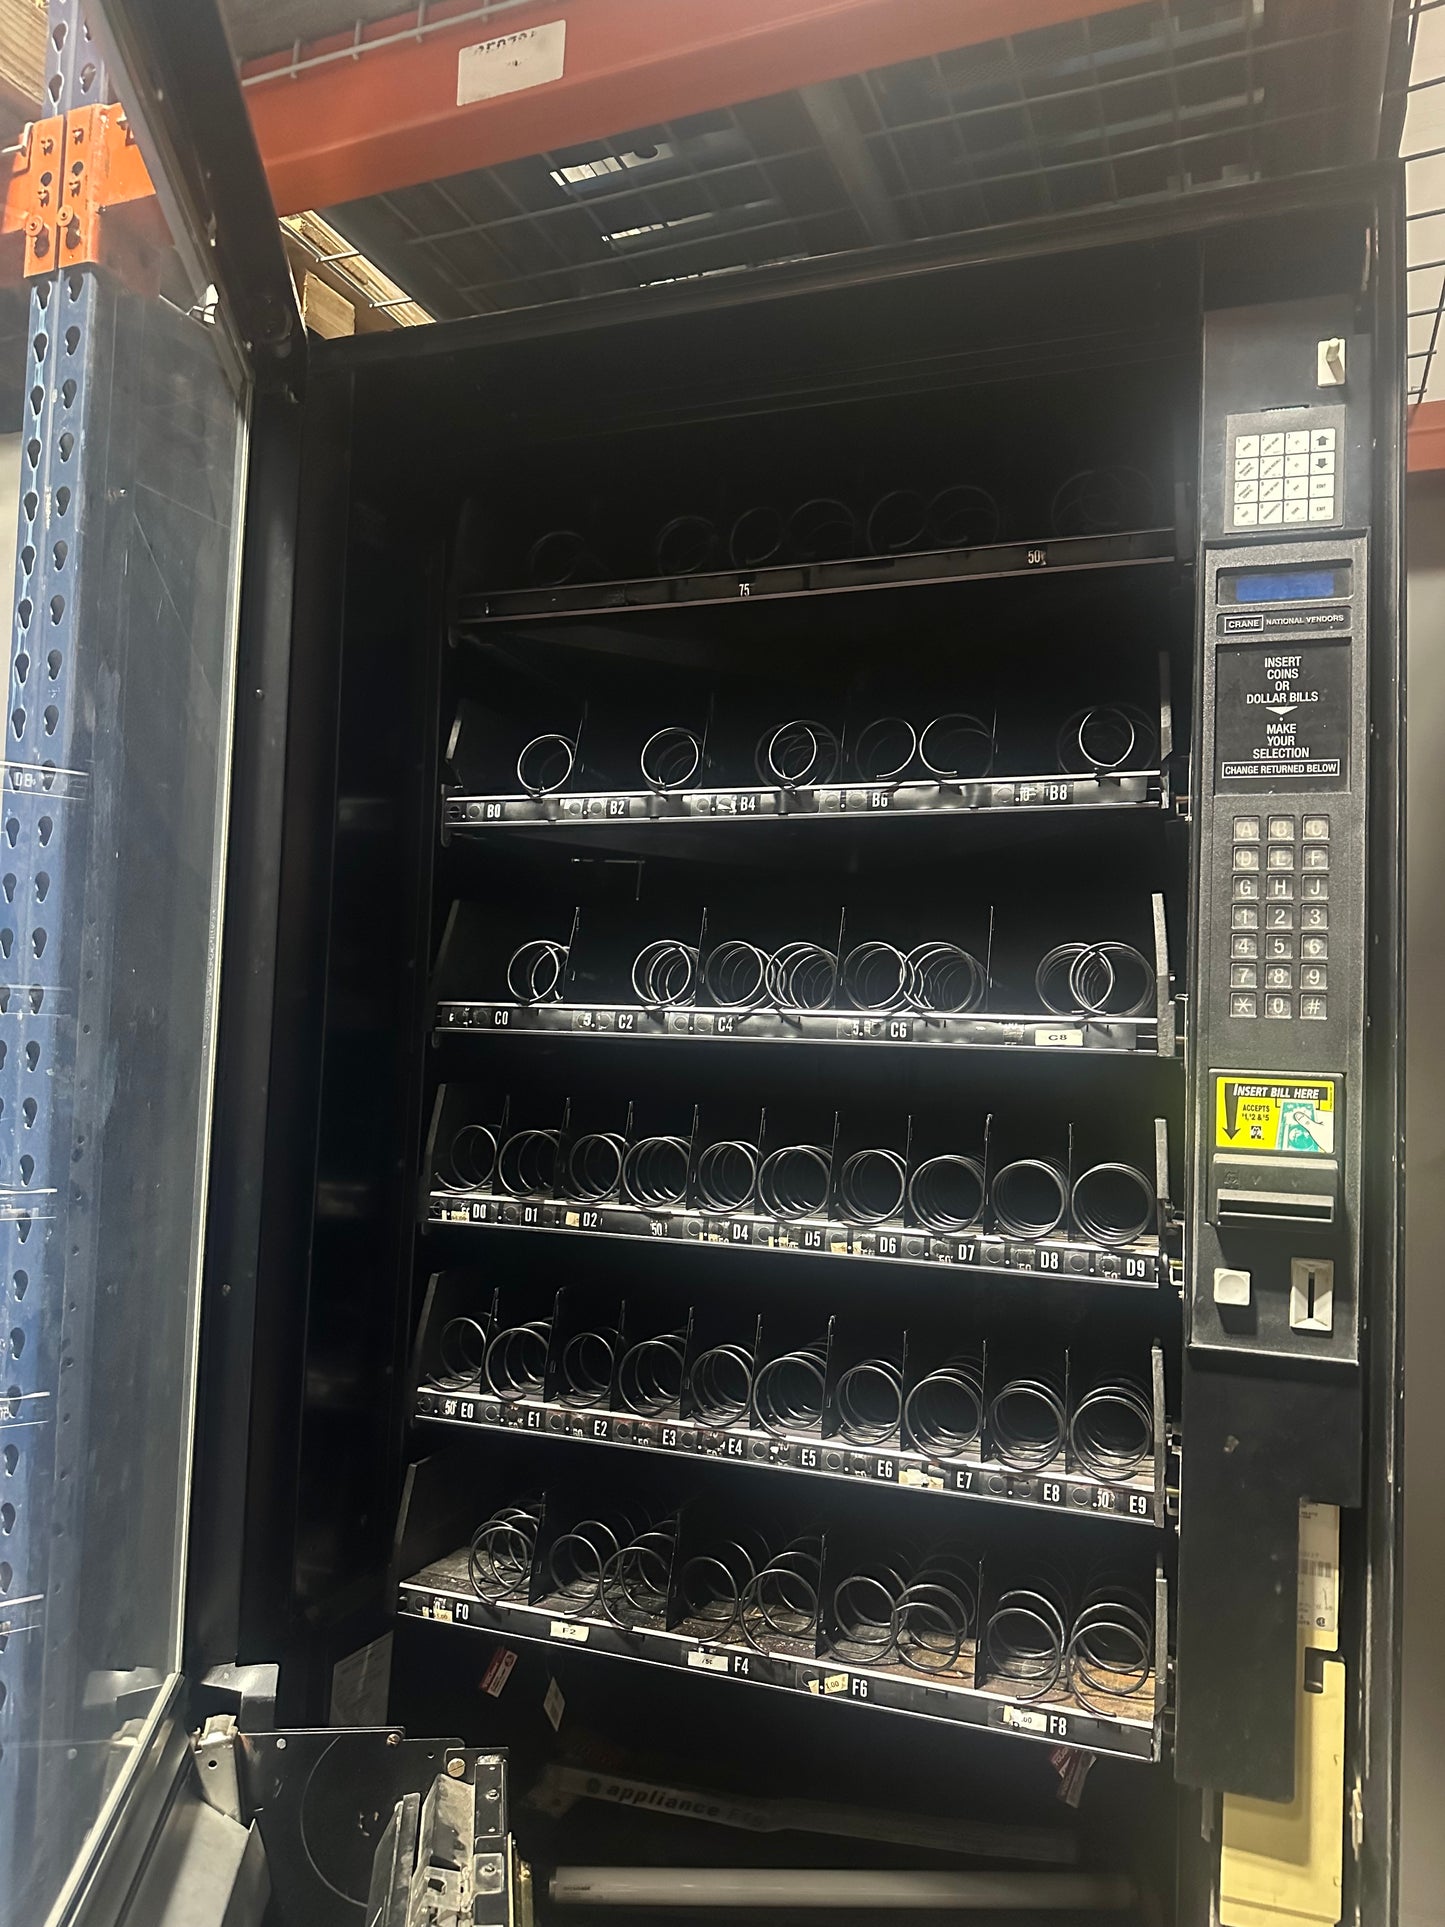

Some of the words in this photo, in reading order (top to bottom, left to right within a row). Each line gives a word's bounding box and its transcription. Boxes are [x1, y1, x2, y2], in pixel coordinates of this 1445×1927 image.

[738, 583, 750, 597] 75
[1228, 619, 1260, 629] CRANE
[1266, 616, 1304, 626] NATIONAL
[1306, 614, 1344, 624] VENDORS
[1264, 656, 1302, 668] INSERT
[1267, 668, 1299, 679] COINS
[1275, 681, 1290, 691] OR
[1246, 692, 1287, 704] DOLLAR
[1289, 691, 1319, 702] BILLS
[1266, 724, 1297, 734] MAKE
[1266, 736, 1295, 746] YOUR
[1252, 748, 1310, 759] SELECTION
[1225, 765, 1258, 775] CHANGE
[1260, 764, 1305, 774] RETURNED
[1306, 763, 1337, 774] BELOW
[872, 792, 888, 808] B6
[1050, 784, 1068, 801] B8
[486, 804, 500, 818] B0
[610, 800, 625, 815] B2
[740, 796, 756, 812] B4
[1240, 822, 1252, 837] A
[1311, 850, 1321, 866] F
[1240, 879, 1251, 895] G
[1274, 879, 1286, 895] H
[1310, 879, 1320, 895] J
[1241, 908, 1248, 924] 1
[1274, 908, 1286, 924] 2
[1310, 908, 1320, 924] 3
[1238, 938, 1250, 954] 4
[1274, 938, 1285, 954] 5
[1309, 938, 1320, 954] 6
[1238, 968, 1249, 983] 7
[1274, 968, 1284, 984] 8
[1309, 968, 1320, 984] 9
[1273, 998, 1284, 1014] 0
[1308, 998, 1320, 1014] #
[494, 1010, 509, 1026] C0
[618, 1014, 633, 1030] C2
[718, 1016, 733, 1032] C4
[890, 1022, 907, 1038] C6
[1233, 1084, 1268, 1097] INSERT
[1270, 1086, 1291, 1098] BILL
[1294, 1088, 1320, 1100] HERE
[1242, 1104, 1270, 1113] ACCEPTS
[472, 1204, 487, 1219] D0
[524, 1207, 538, 1222] D1
[582, 1212, 598, 1228] D2
[732, 1224, 748, 1240] D4
[804, 1230, 821, 1246] D5
[879, 1236, 896, 1254] D6
[958, 1244, 975, 1262] D7
[1040, 1252, 1059, 1270] D8
[1126, 1258, 1146, 1278] D9
[461, 1402, 474, 1419] E0
[528, 1412, 540, 1428] E1
[594, 1420, 608, 1436] E2
[662, 1429, 676, 1446] E3
[728, 1438, 742, 1456] E4
[801, 1448, 816, 1466] E5
[877, 1460, 893, 1478] E6
[956, 1471, 973, 1490] E7
[1043, 1483, 1060, 1502] E8
[1129, 1495, 1147, 1515] E9
[455, 1602, 469, 1620] F0
[562, 1628, 576, 1636] F2
[734, 1656, 750, 1675] F4
[852, 1678, 868, 1698] F6
[1049, 1716, 1068, 1736] F8
[607, 1782, 720, 1818] appliance
